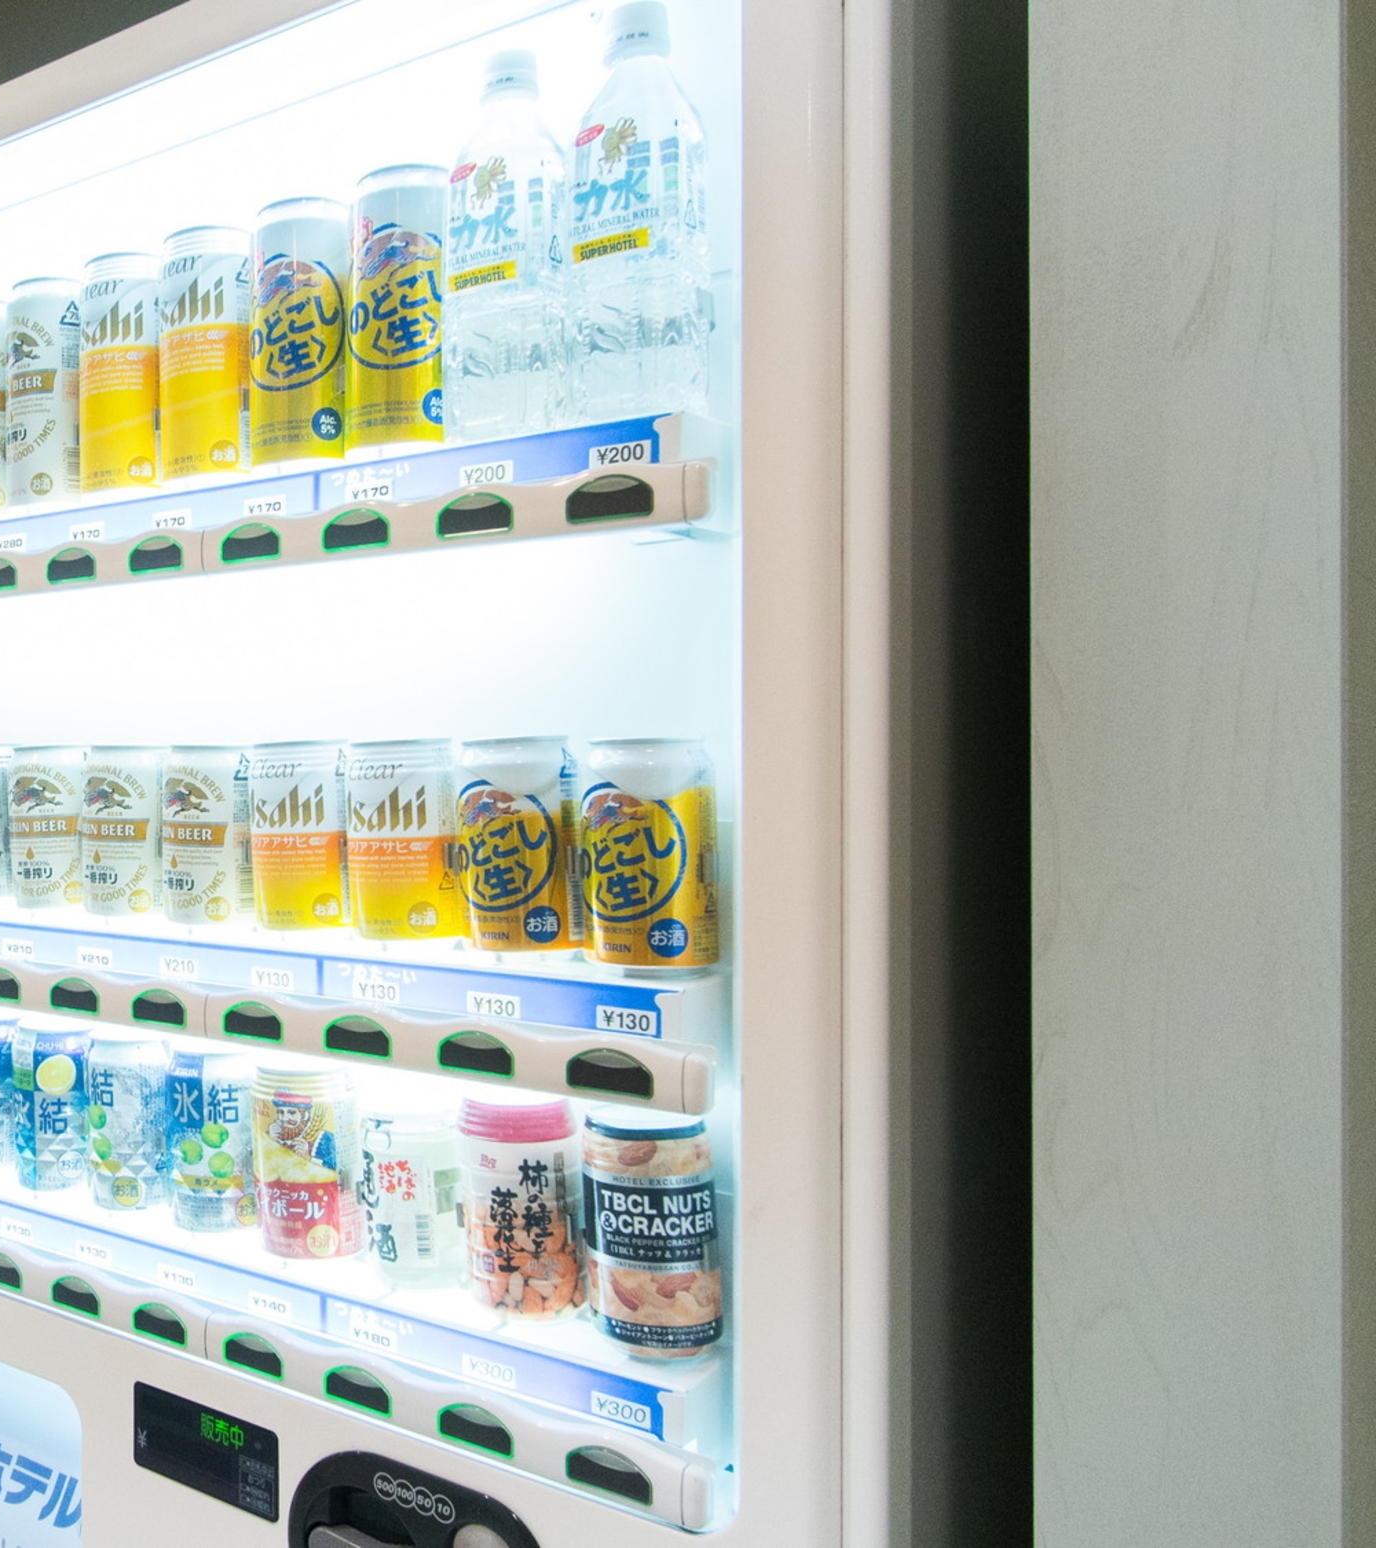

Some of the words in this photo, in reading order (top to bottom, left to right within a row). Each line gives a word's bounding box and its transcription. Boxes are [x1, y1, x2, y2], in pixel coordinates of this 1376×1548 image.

[573, 169, 650, 222] 力水
[633, 208, 660, 220] WATER
[449, 206, 517, 254] 力水
[350, 270, 442, 335] のどごし
[30, 322, 54, 347] BREW
[250, 296, 339, 359] のどごし
[13, 376, 42, 392] BEER
[34, 418, 56, 446] TIMES
[321, 425, 335, 435] 5%
[596, 443, 644, 466] ¥200
[464, 464, 506, 485] ¥200
[352, 484, 389, 500] ¥170
[248, 500, 282, 514] ¥170
[155, 516, 186, 529] ¥170
[72, 529, 100, 540] ¥170
[251, 759, 302, 780] Clear
[348, 760, 403, 781] Clear
[53, 773, 76, 796] BREW
[123, 775, 148, 800] BREW
[201, 776, 226, 803] BREW
[251, 783, 325, 829] sahi
[348, 785, 427, 833] sahi
[33, 820, 67, 833] BEER
[101, 824, 135, 837] BEER
[178, 827, 212, 841] BEER
[459, 820, 547, 873] のどごし
[582, 827, 677, 879] のどごし
[35, 880, 61, 898] GOOD
[62, 856, 81, 884] TIMES
[99, 888, 125, 904] GOOD
[127, 865, 148, 892] TIMES
[177, 893, 203, 910] GOOD
[204, 869, 227, 898] TIMES
[526, 916, 558, 934] お酒
[481, 931, 510, 941] KIRIN
[650, 931, 685, 948] お酒
[7, 943, 33, 955] ¥210
[603, 942, 632, 953] KIRIN
[81, 953, 110, 966] ¥210
[164, 957, 195, 975] ¥210
[256, 969, 290, 987] ¥130
[358, 981, 396, 1001] ¥130
[473, 995, 516, 1016] ¥130
[602, 1010, 651, 1031] ¥130
[90, 1069, 114, 1108] 結
[173, 1081, 238, 1124] 氷結
[39, 1097, 68, 1135] 結
[59, 1156, 83, 1171] お酒
[113, 1181, 139, 1198] お酒
[612, 1175, 646, 1186] HOTEL
[649, 1175, 701, 1187] EXCLUSIVE
[601, 1189, 657, 1215] TBCL
[663, 1190, 711, 1214] NUTS
[6, 1224, 31, 1237] ¥130
[606, 1233, 630, 1244] BLACK
[632, 1239, 664, 1247] PEPPER
[79, 1245, 107, 1259] ¥130
[163, 1270, 194, 1287] ¥130
[253, 1296, 286, 1313] ¥140
[353, 1328, 390, 1347] ¥180
[468, 1359, 514, 1382] ¥300
[596, 1398, 646, 1424] ¥300
[137, 1429, 147, 1449] ¥
[200, 1413, 245, 1450] 販売中
[376, 1479, 394, 1494] 500
[397, 1488, 413, 1501] 100
[417, 1495, 432, 1508] 50
[437, 1504, 450, 1517] 10
